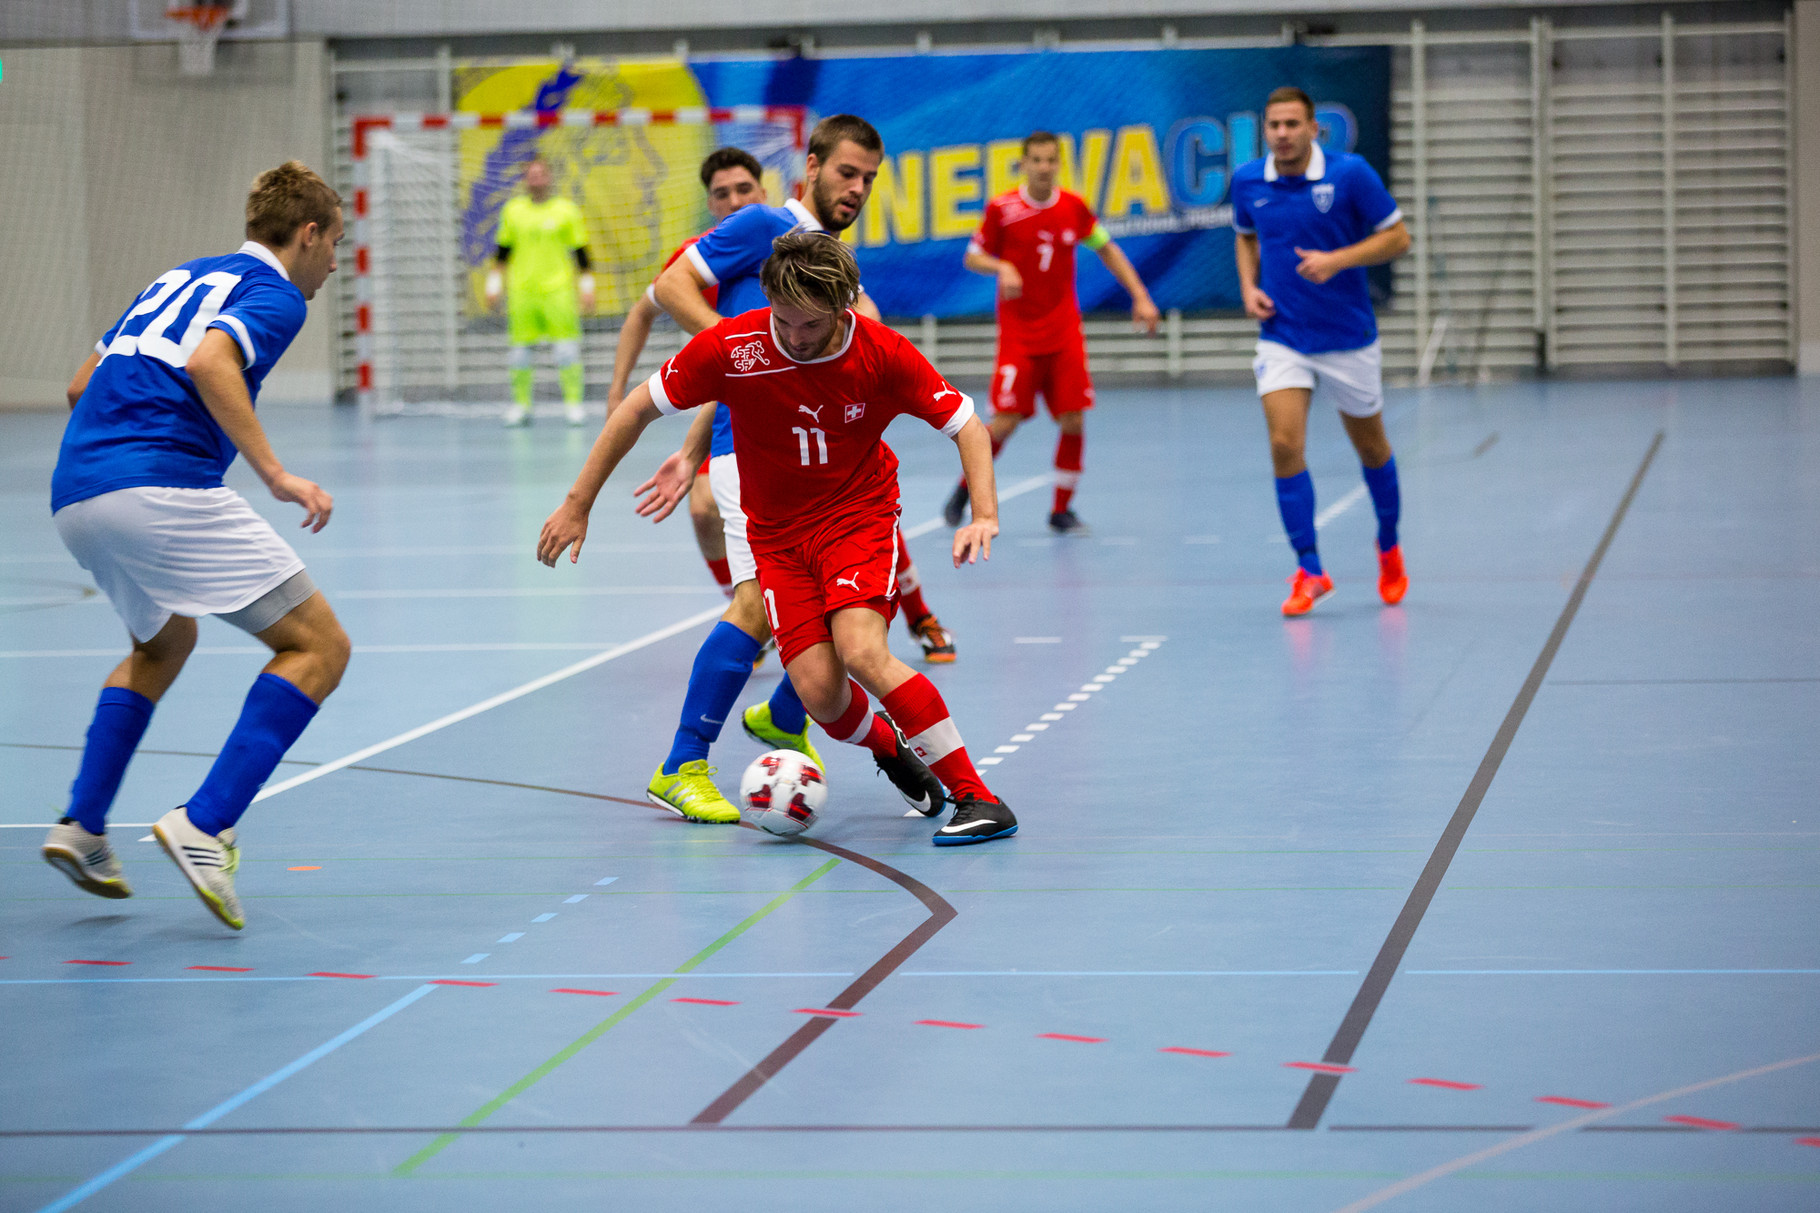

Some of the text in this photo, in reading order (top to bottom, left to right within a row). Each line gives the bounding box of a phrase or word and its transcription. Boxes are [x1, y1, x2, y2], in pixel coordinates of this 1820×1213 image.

[1037, 243, 1054, 272] 7
[96, 269, 242, 368] 20
[1001, 364, 1017, 393] 7
[791, 426, 828, 466] 11
[763, 588, 780, 630] 1
